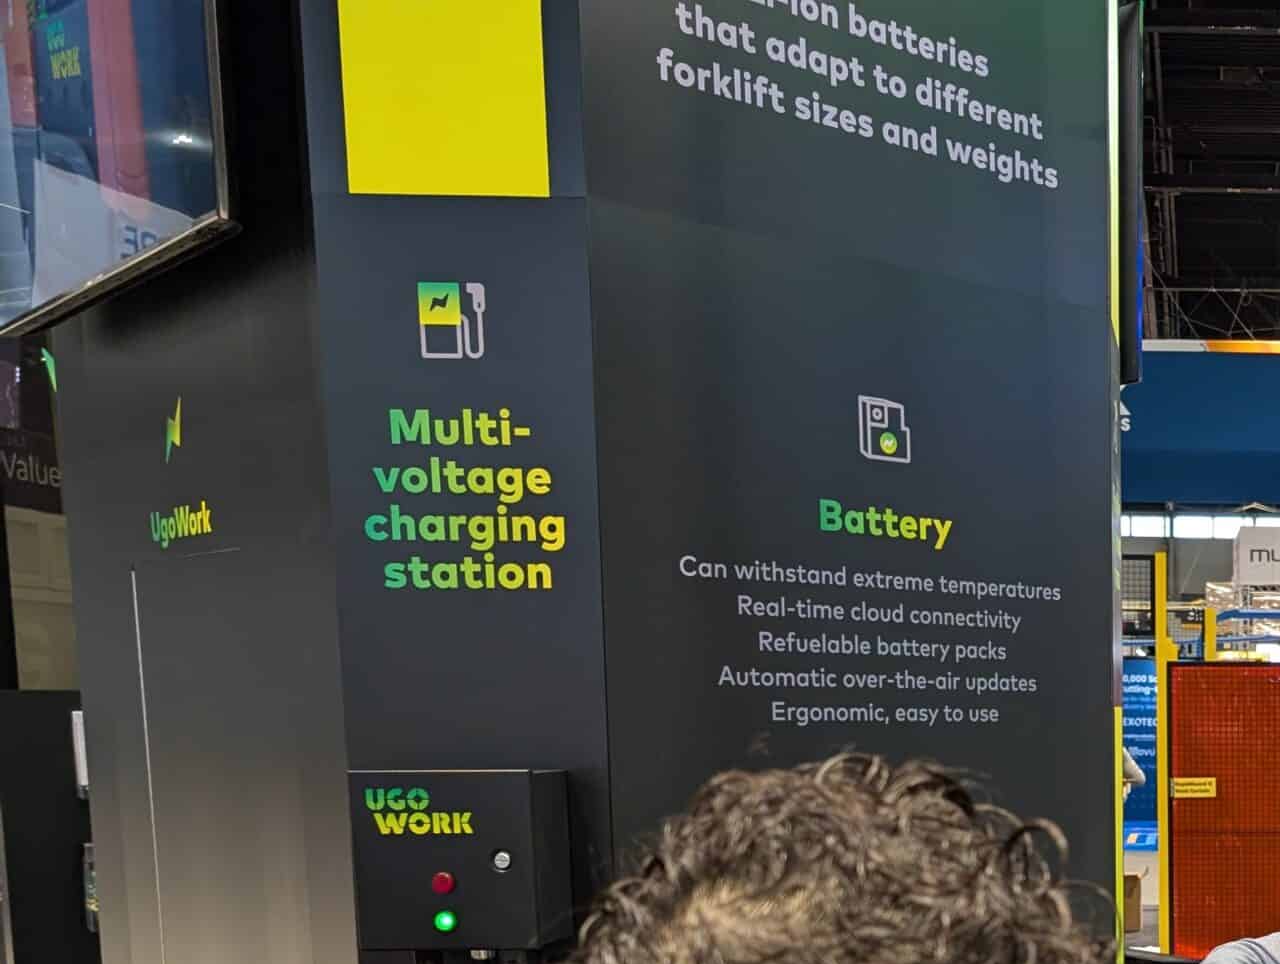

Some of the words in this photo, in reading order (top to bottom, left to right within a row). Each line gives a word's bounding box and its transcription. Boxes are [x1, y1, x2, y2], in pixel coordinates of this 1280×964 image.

[748, 0, 838, 29] -ion
[848, 3, 990, 77] batteries
[676, 2, 756, 54] that
[766, 37, 865, 87] adapt
[873, 64, 907, 98] to
[916, 78, 1043, 140] different
[657, 48, 785, 113] forklift
[795, 92, 873, 138] sizes
[882, 120, 937, 155] and
[946, 138, 1058, 189] weights
[389, 408, 531, 445] Multi-
[372, 456, 552, 503] voltage
[150, 500, 212, 549] UgoWork
[364, 504, 566, 551] charging
[818, 499, 953, 550] Battery
[384, 552, 553, 589] station
[679, 554, 727, 578] Can
[735, 561, 847, 586] withstand
[853, 570, 934, 592] extreme
[939, 576, 1061, 601] temperatures
[737, 595, 844, 620] Real-time
[851, 601, 904, 623] cloud
[910, 609, 1021, 634] connectivity
[759, 631, 871, 655] Refuelable
[877, 635, 950, 662] battery
[955, 642, 1007, 663] packs
[718, 666, 837, 688] Automatic
[842, 670, 960, 691] over-the-air
[966, 671, 1037, 695] updates
[771, 701, 889, 726] Ergonomic,
[895, 706, 939, 726] easy
[943, 706, 964, 722] to
[969, 709, 999, 723] use
[365, 787, 430, 811] UGO
[373, 812, 474, 834] WORK
